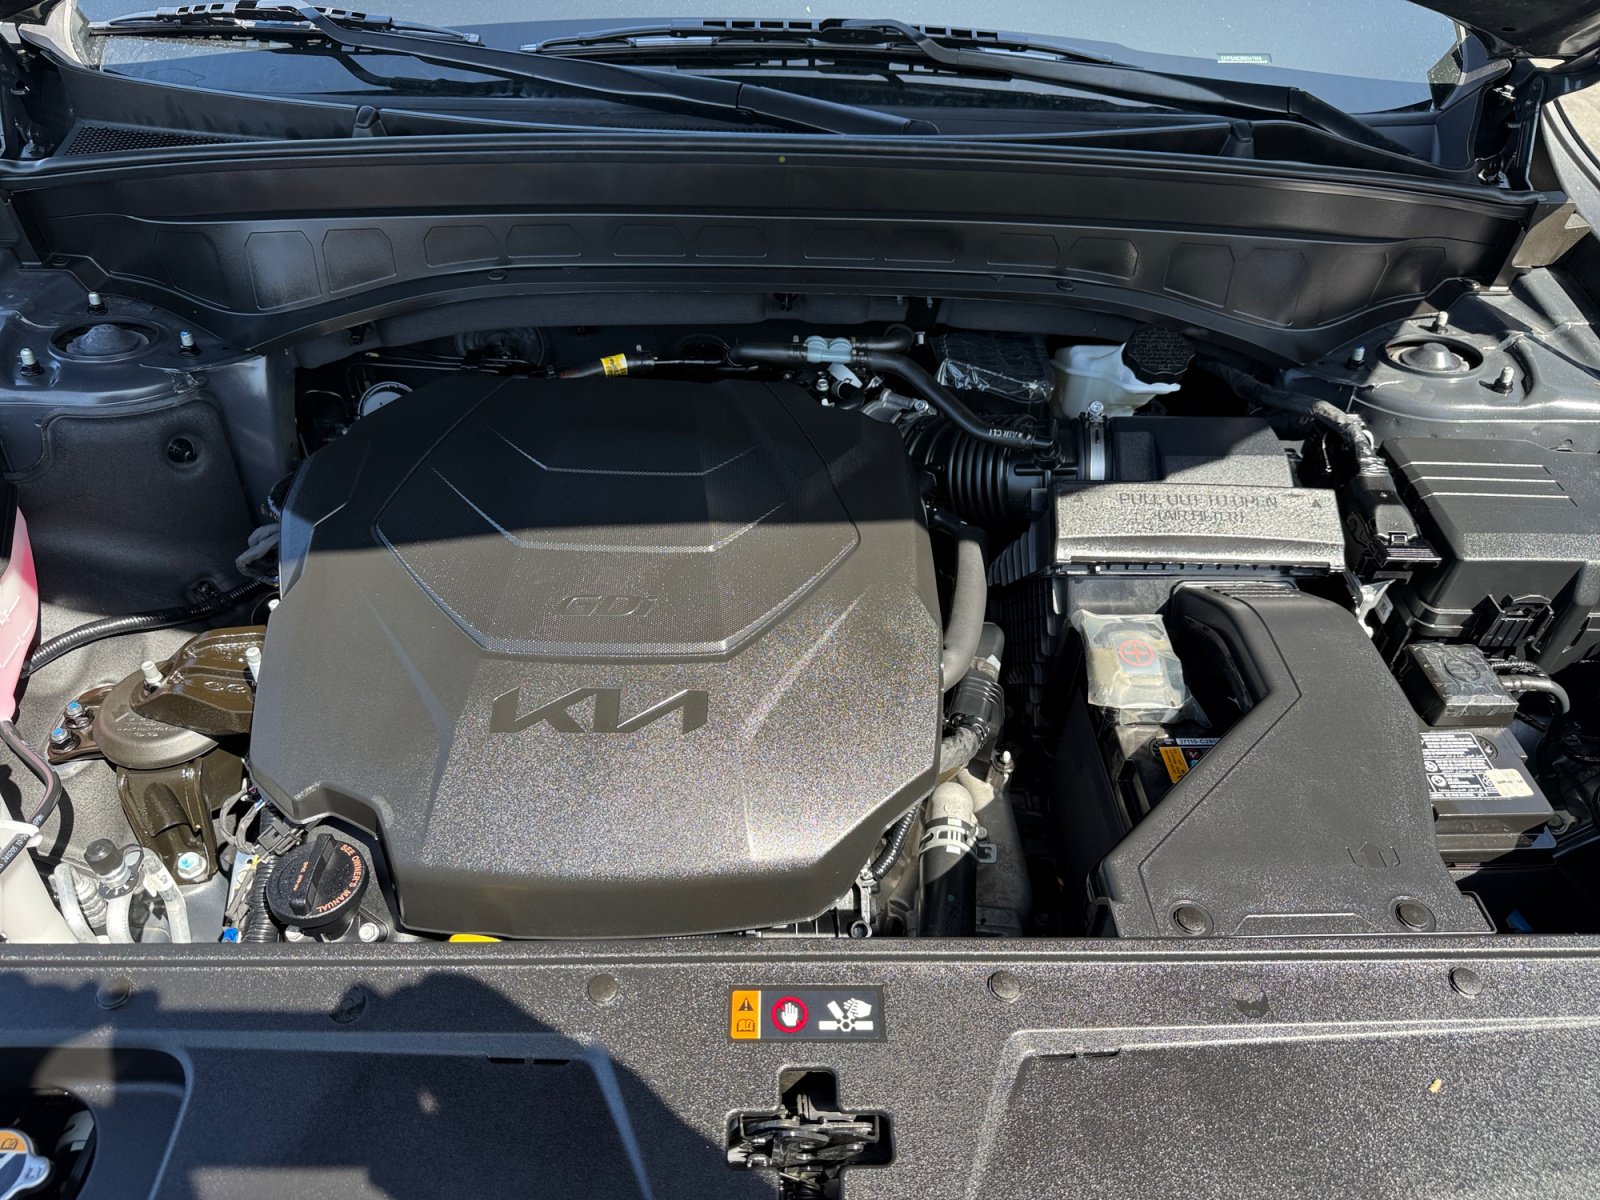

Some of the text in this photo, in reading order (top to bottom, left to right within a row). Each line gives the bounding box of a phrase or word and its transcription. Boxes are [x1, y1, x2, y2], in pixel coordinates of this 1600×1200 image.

[1119, 493, 1278, 508] PULL OUT TO OPEN
[489, 686, 709, 735] KIA
[316, 843, 362, 913] SEE OWNER'S MANUAL
